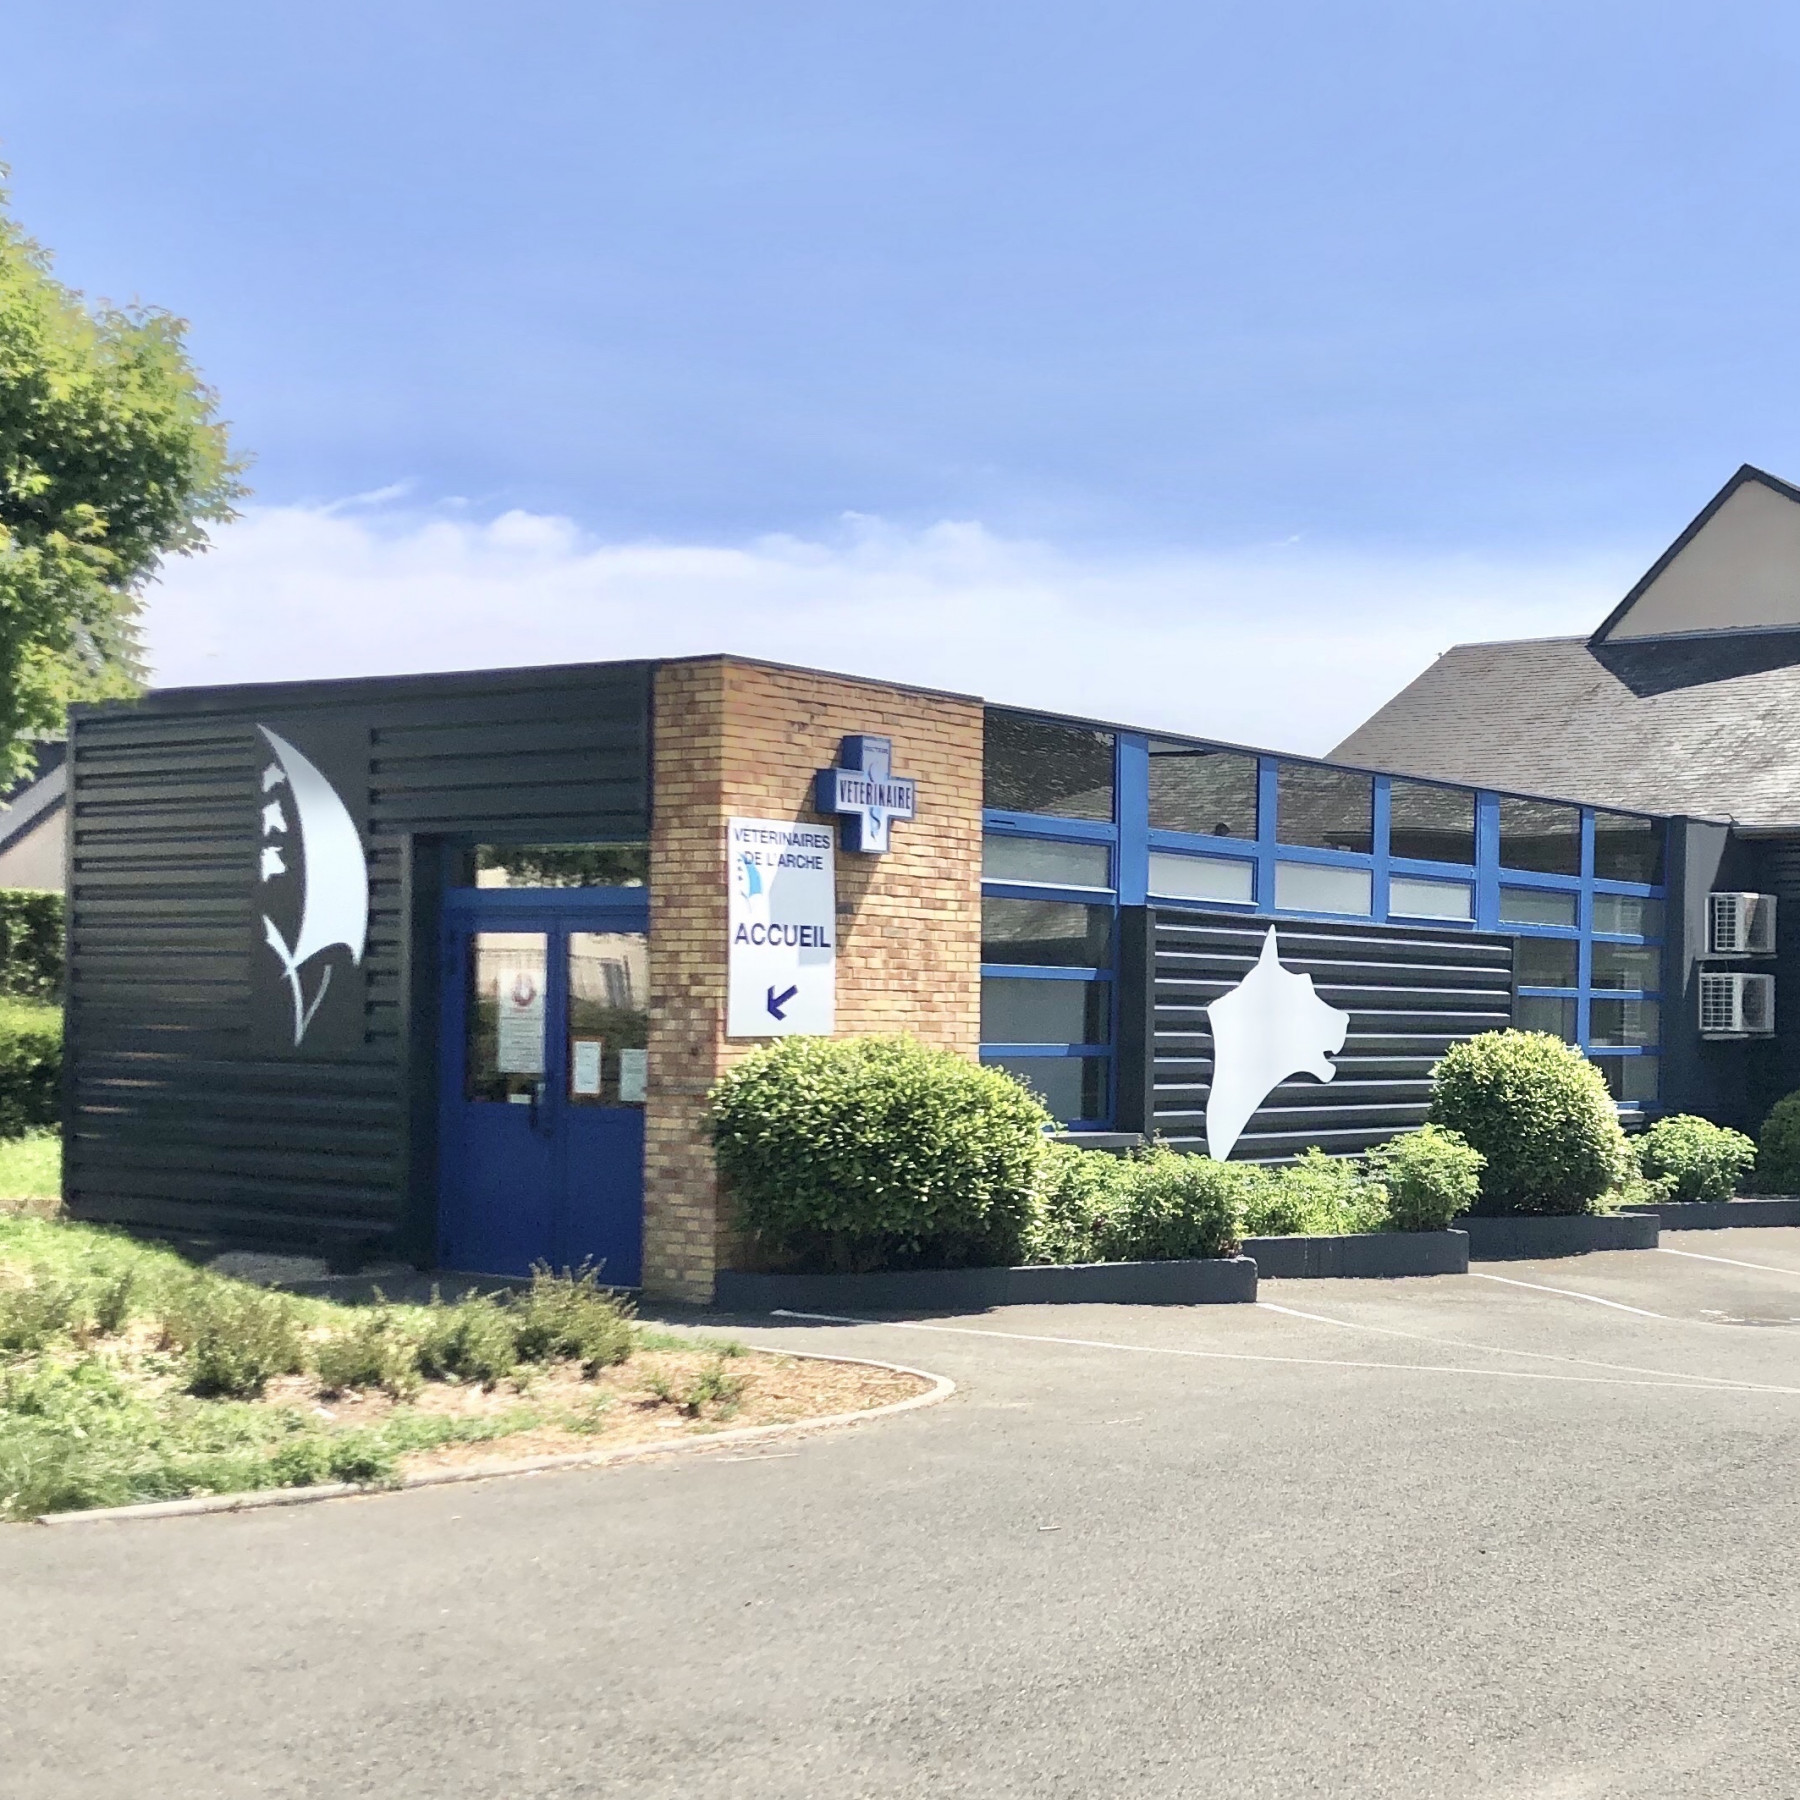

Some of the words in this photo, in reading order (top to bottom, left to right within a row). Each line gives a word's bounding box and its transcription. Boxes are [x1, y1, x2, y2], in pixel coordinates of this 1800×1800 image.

[840, 780, 911, 810] VETERINAIRE
[744, 850, 763, 866] DE
[767, 852, 824, 870] L'ARCHE
[734, 922, 832, 949] ACCUEIL
